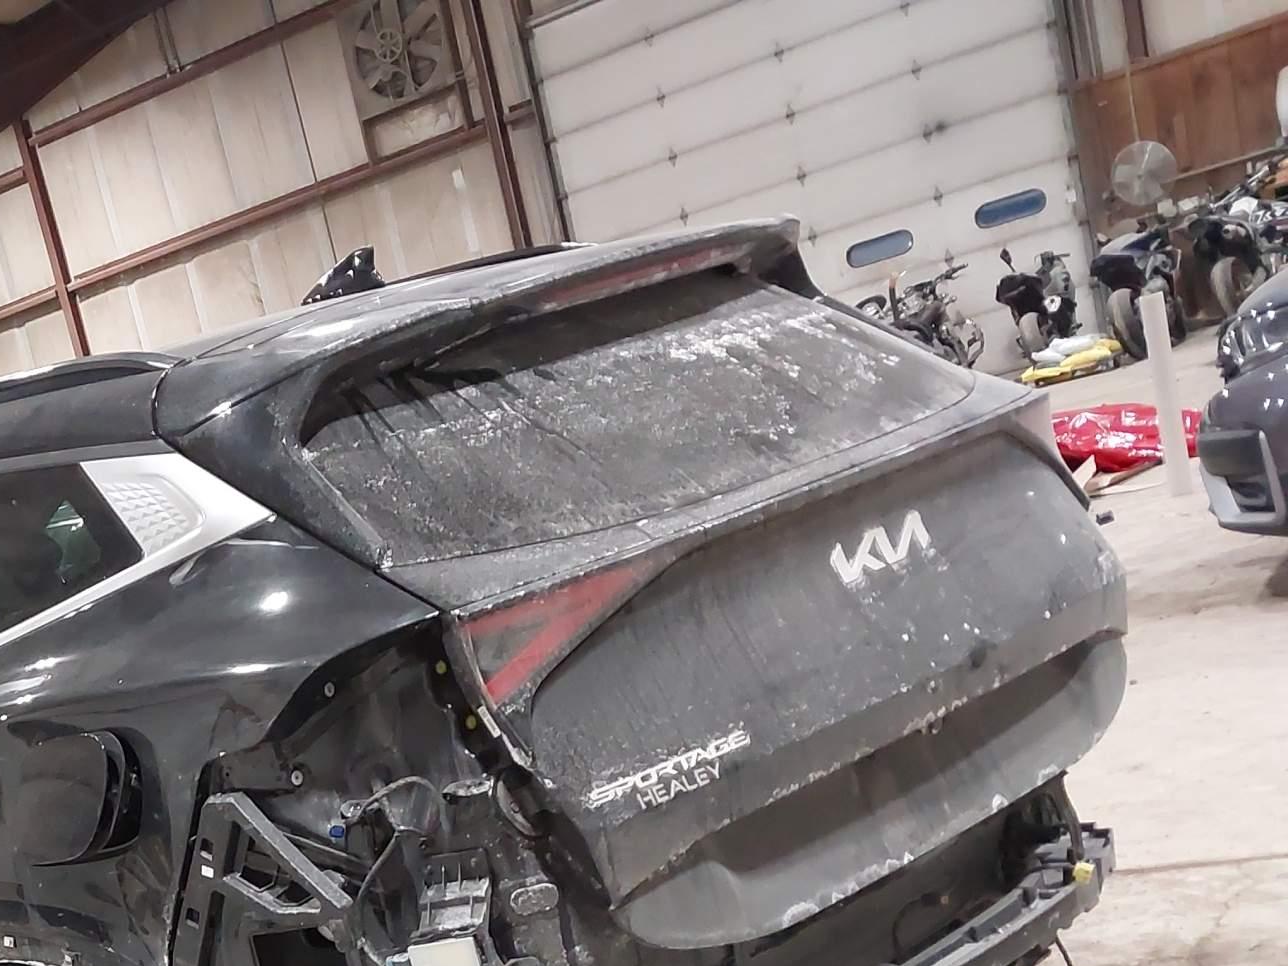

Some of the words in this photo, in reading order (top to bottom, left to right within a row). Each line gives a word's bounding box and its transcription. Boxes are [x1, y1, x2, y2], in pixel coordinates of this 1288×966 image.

[830, 509, 931, 583] KIA
[586, 730, 751, 808] SPORTAGE
[636, 760, 720, 809] HEALEY
